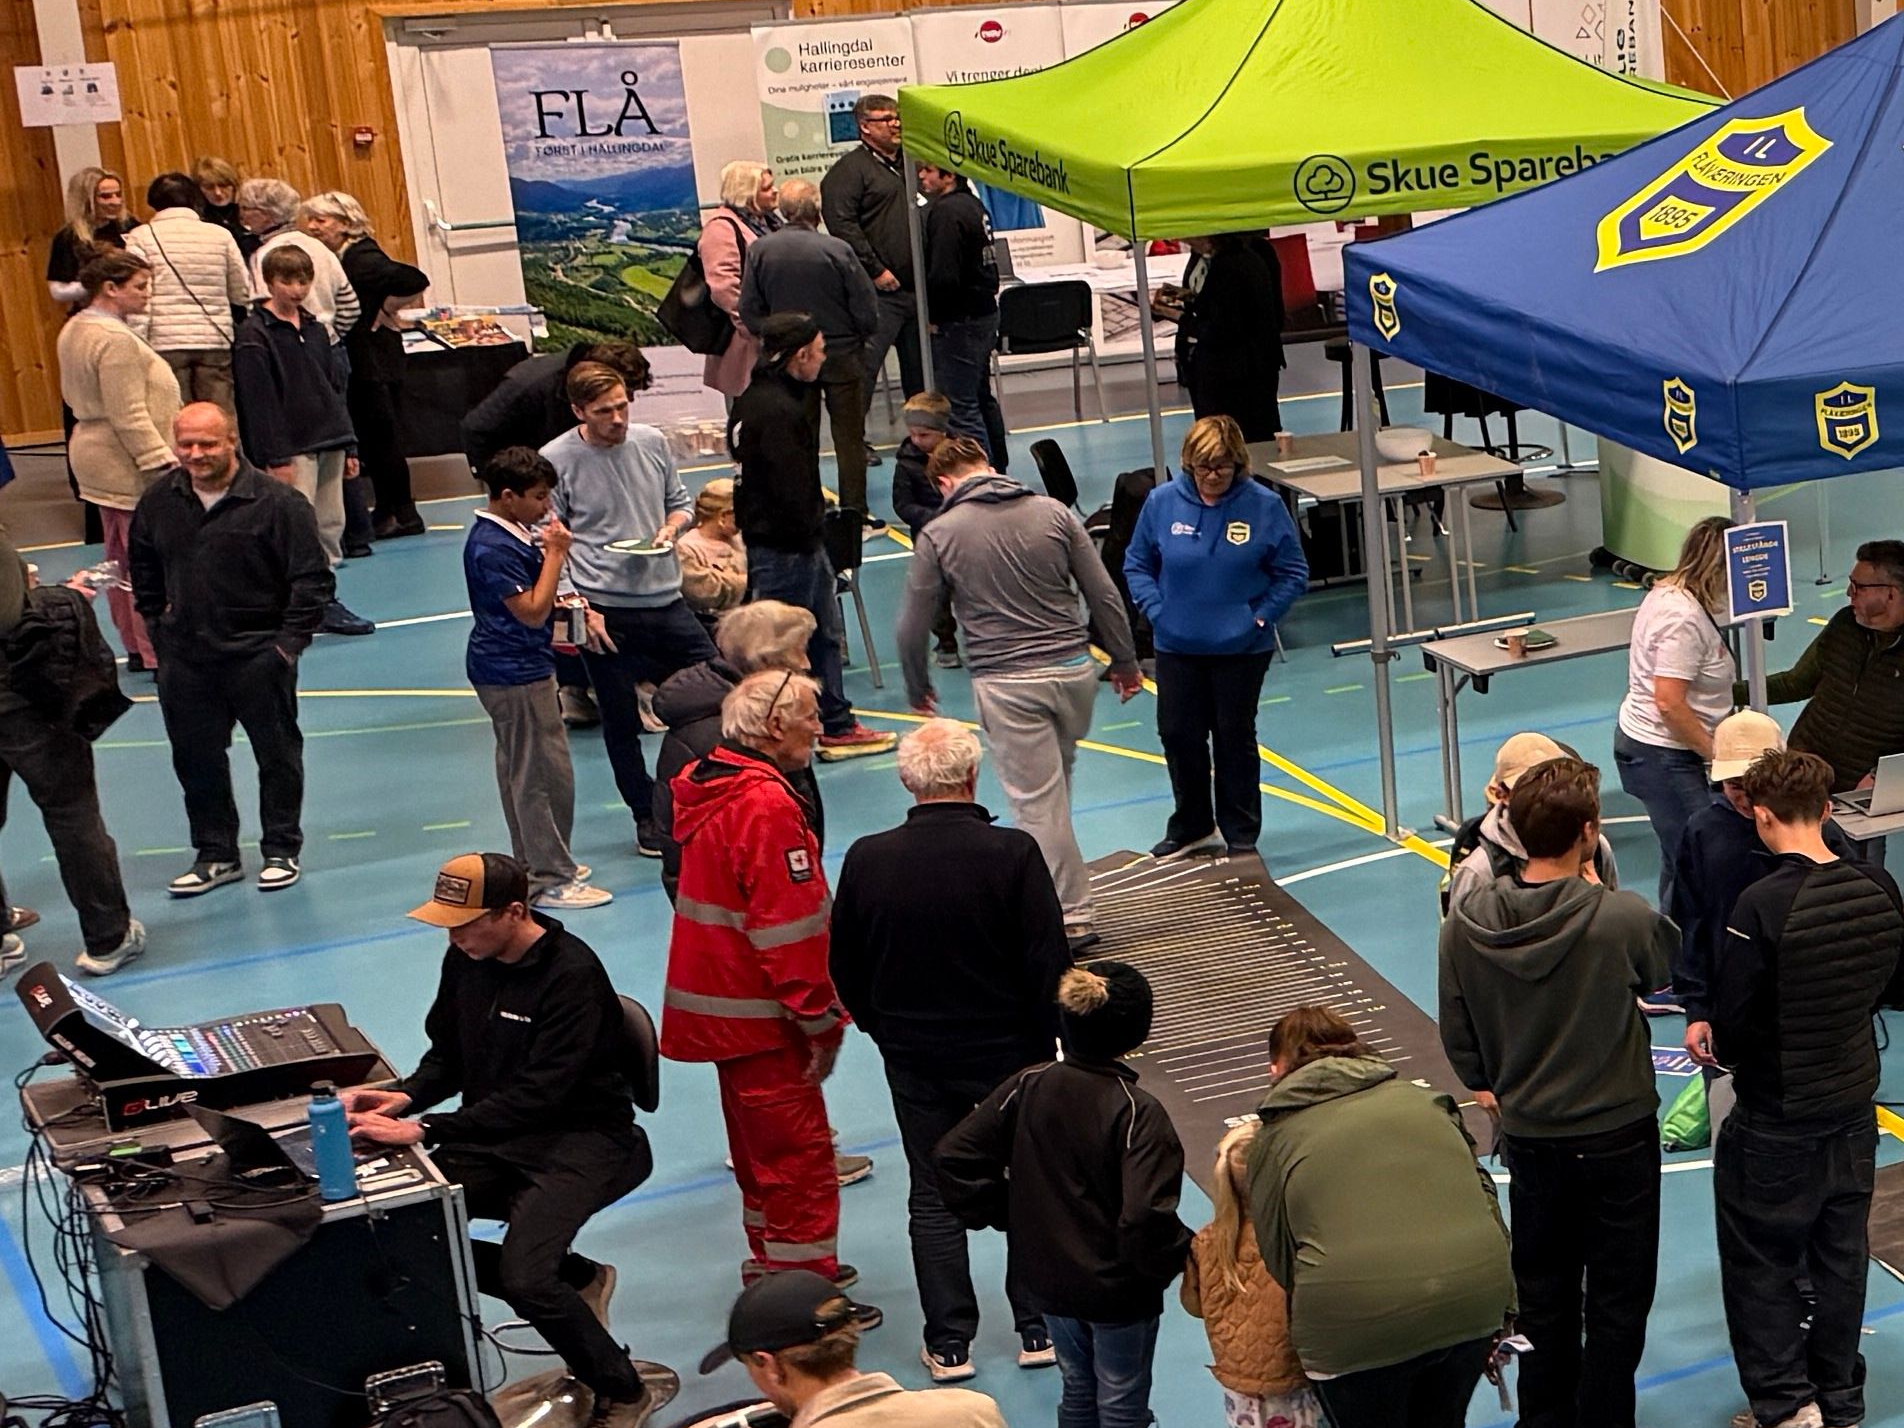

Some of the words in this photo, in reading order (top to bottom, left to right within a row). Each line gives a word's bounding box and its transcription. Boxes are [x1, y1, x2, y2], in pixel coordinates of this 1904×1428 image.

[799, 39, 873, 58] Hallingdal
[800, 54, 906, 74] karrieresenter
[946, 71, 957, 81] Vi
[529, 70, 663, 139] FLÅ
[1743, 136, 1767, 159] IL
[965, 128, 998, 167] Skue
[998, 139, 1070, 194] Sparebank
[1367, 159, 1461, 197] Skue
[1469, 145, 1612, 193] Spareb
[1692, 151, 1787, 187] FLÅVÆRINGEN
[1649, 202, 1698, 231] 1895
[1839, 394, 1856, 405] IL
[1838, 427, 1861, 440] 1895
